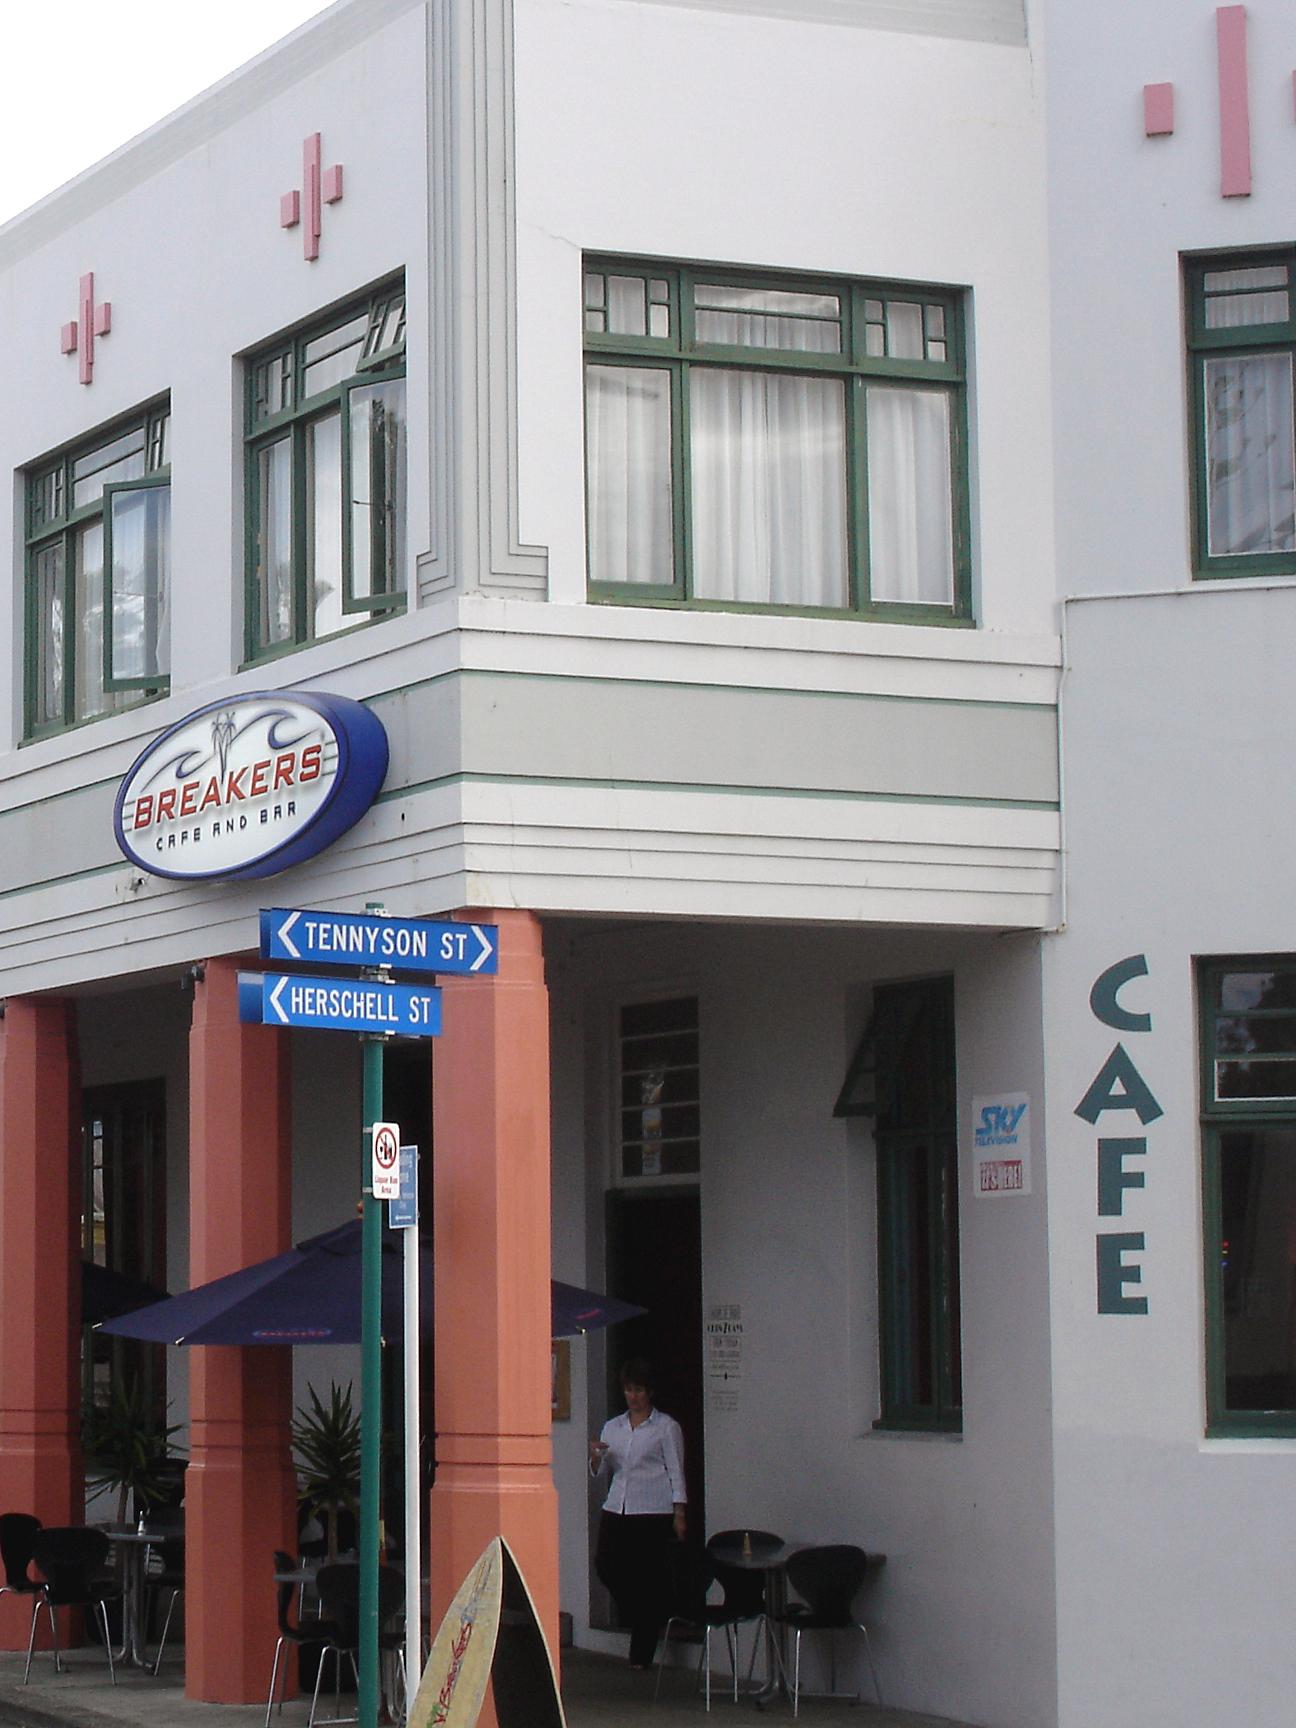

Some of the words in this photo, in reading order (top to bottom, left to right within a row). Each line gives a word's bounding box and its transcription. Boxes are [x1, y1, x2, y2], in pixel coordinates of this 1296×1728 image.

[134, 744, 322, 830] BREAKERS
[156, 827, 201, 851] CAFE
[212, 814, 247, 837] AND
[260, 800, 296, 824] BAR
[304, 922, 427, 957] TENNYSON
[440, 932, 467, 961] ST
[291, 986, 399, 1022] HERSCHELL
[409, 996, 431, 1024] ST
[975, 1103, 1028, 1136] SKY
[1073, 953, 1164, 1315] CAFE
